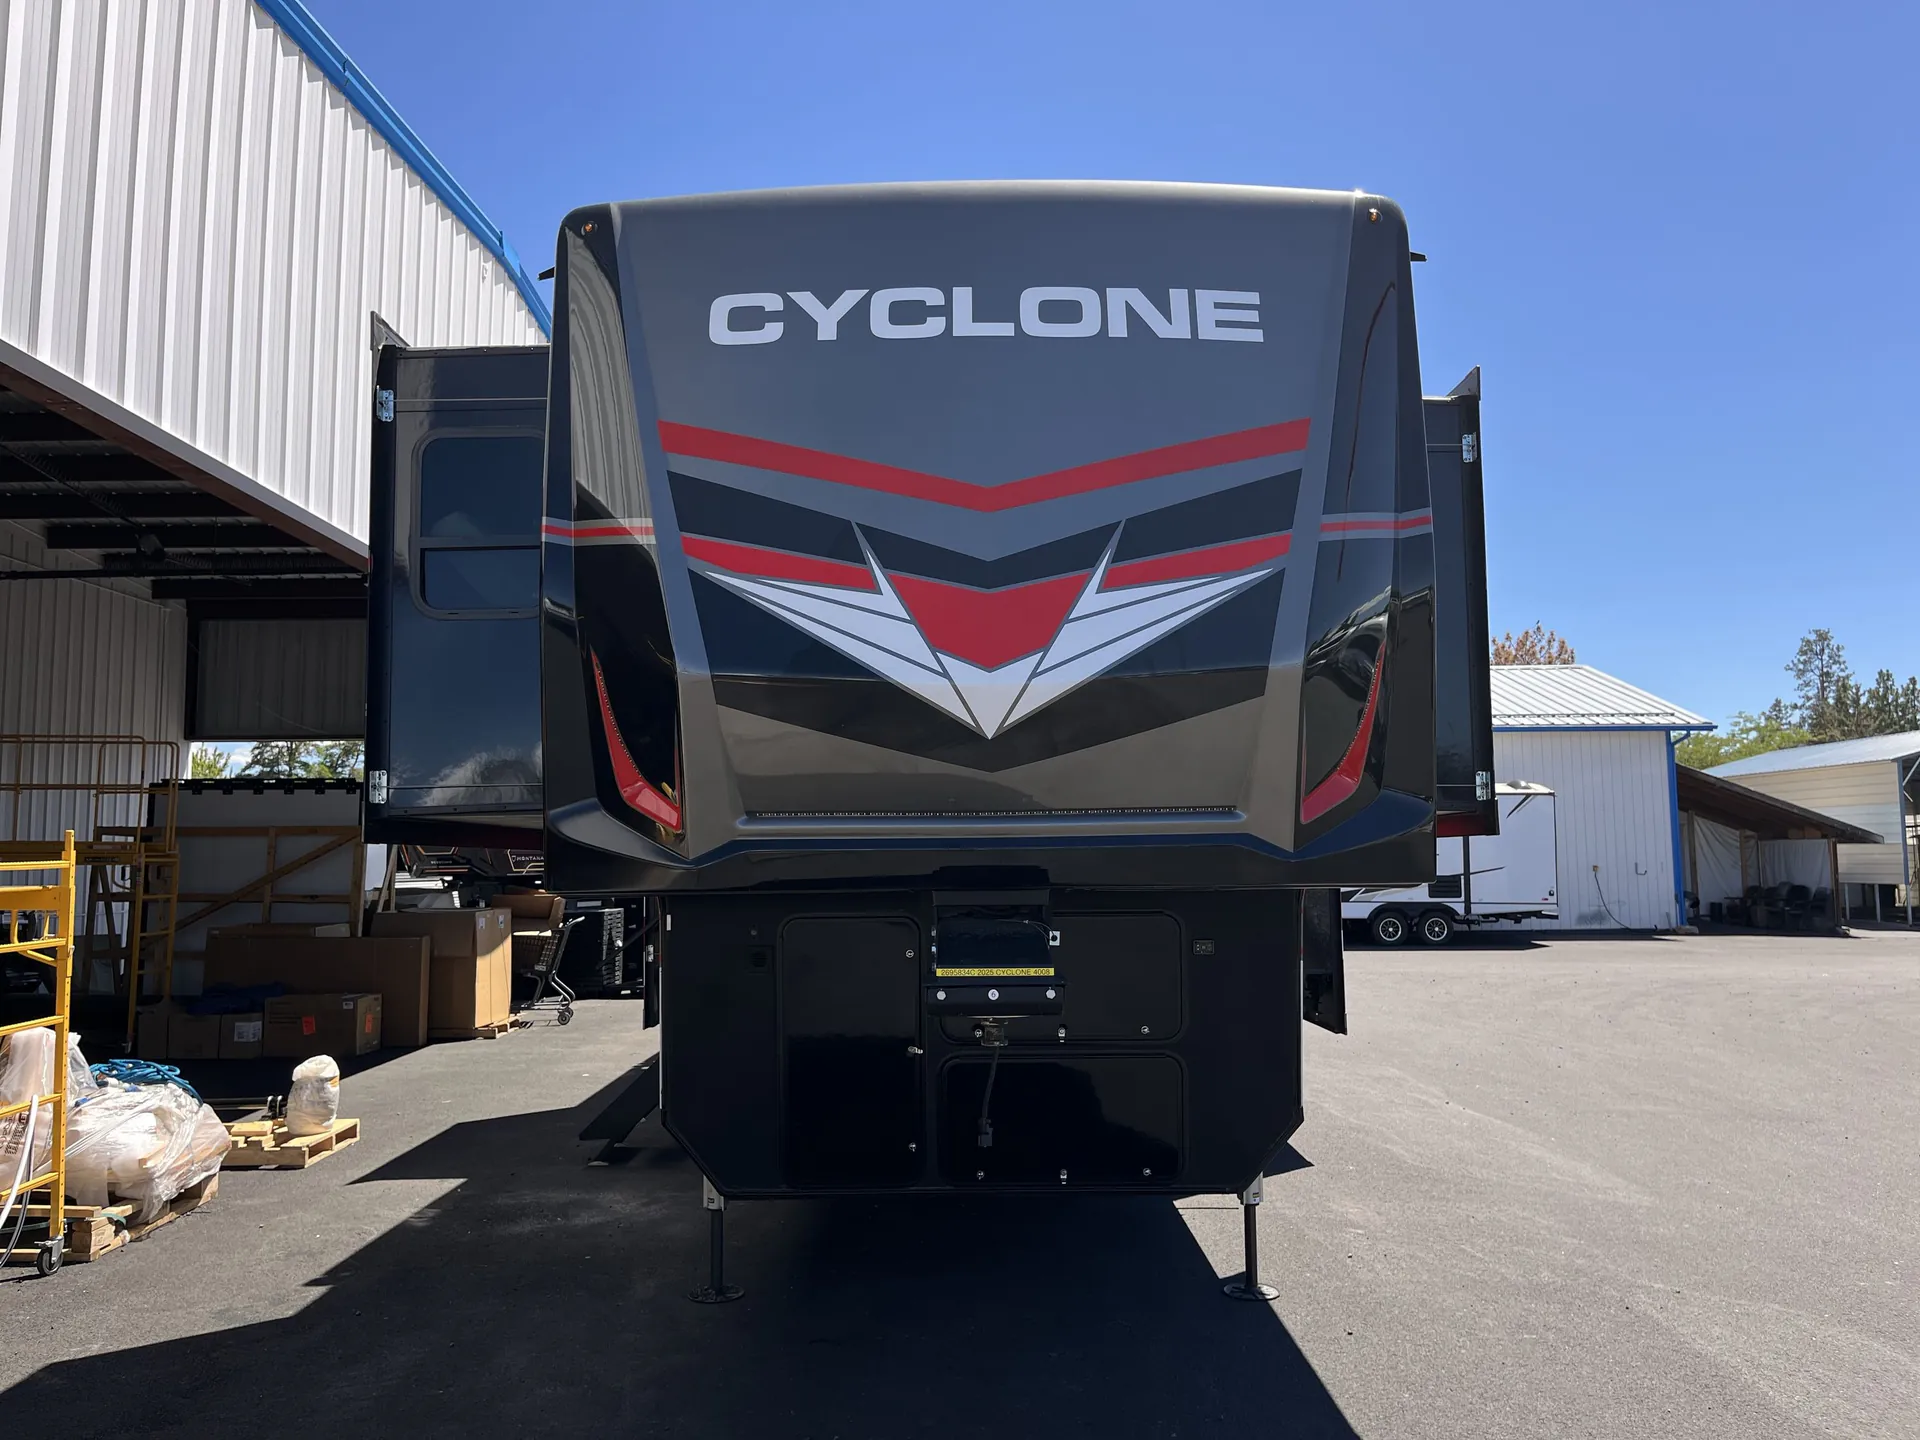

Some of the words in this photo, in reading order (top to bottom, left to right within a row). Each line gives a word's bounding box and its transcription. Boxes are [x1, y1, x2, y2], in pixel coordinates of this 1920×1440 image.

[708, 286, 1264, 345] CYCLONE
[977, 968, 995, 976] 2025
[996, 968, 1031, 976] CYCLONE
[1033, 968, 1050, 976] 4008
